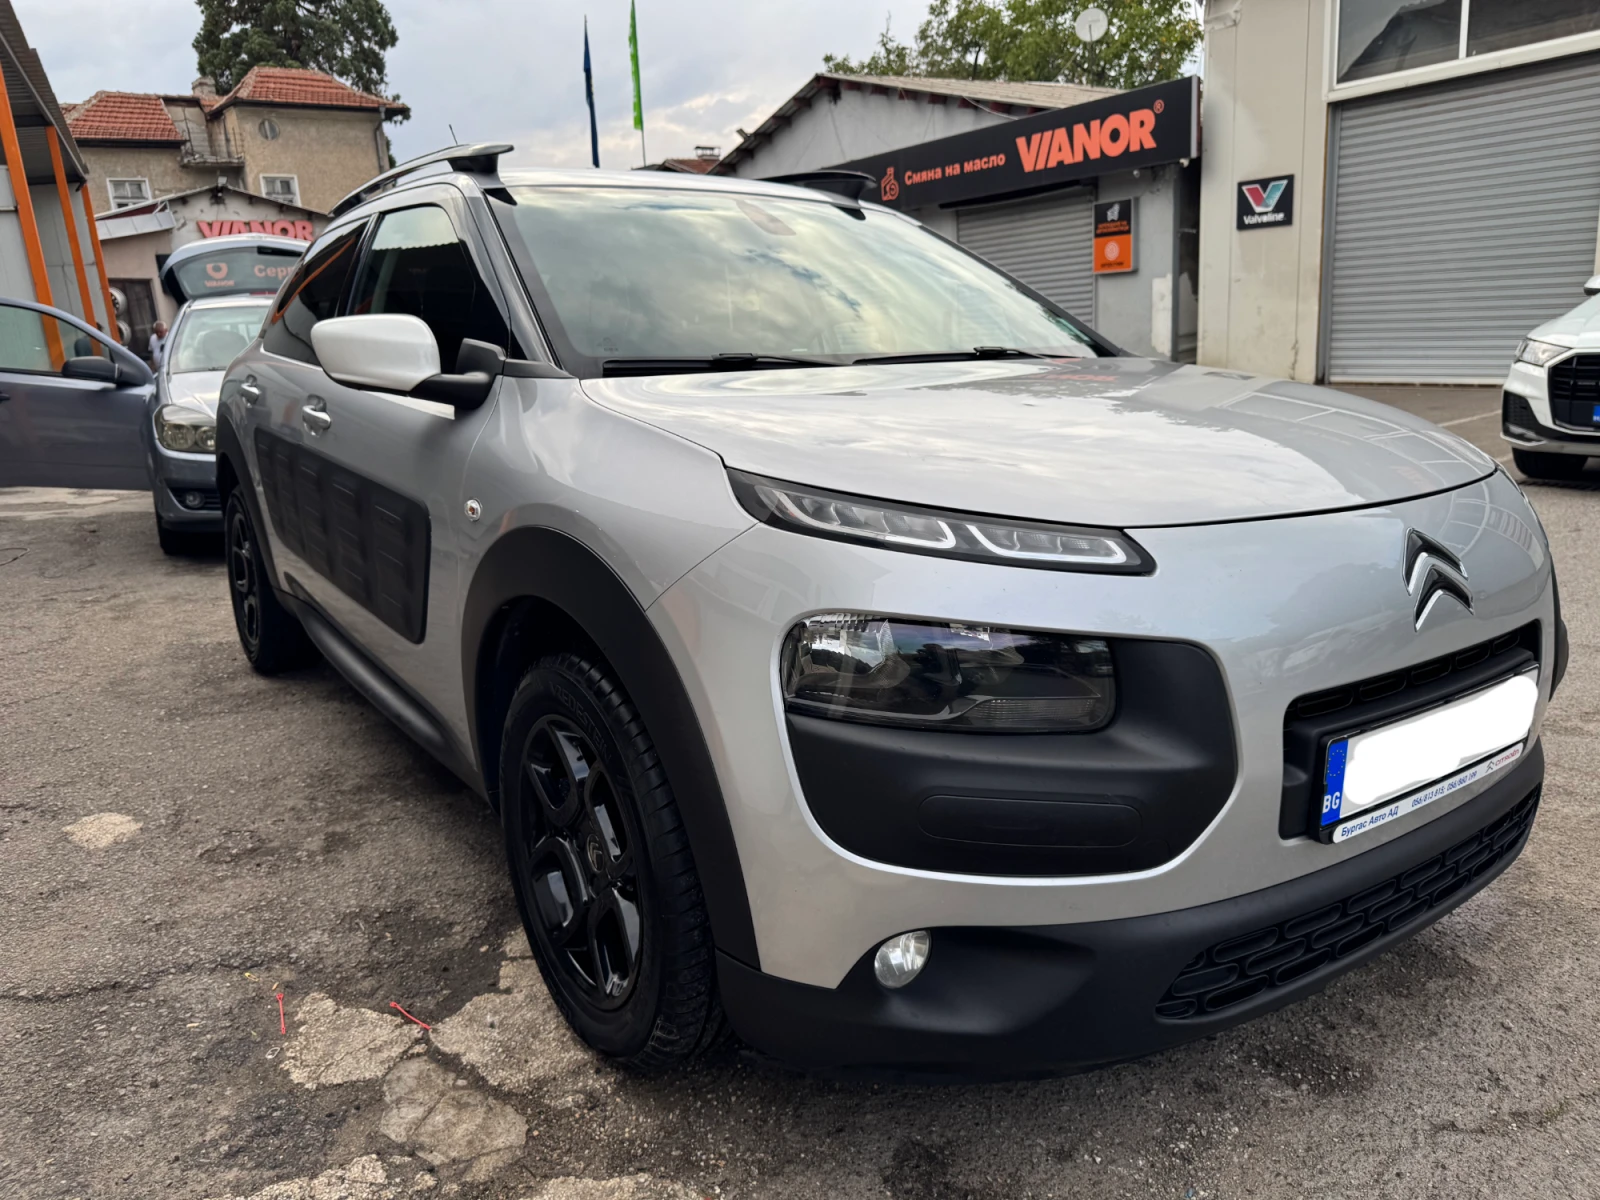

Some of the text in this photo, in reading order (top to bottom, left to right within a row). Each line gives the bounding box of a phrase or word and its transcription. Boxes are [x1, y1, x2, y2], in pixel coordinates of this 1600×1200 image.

[1015, 108, 1157, 173] VIANOR
[904, 153, 1006, 186] Смяна на масло
[1243, 211, 1285, 225] Valvoline
[1322, 791, 1341, 814] BG
[1341, 805, 1399, 837] Бургас Авто АД
